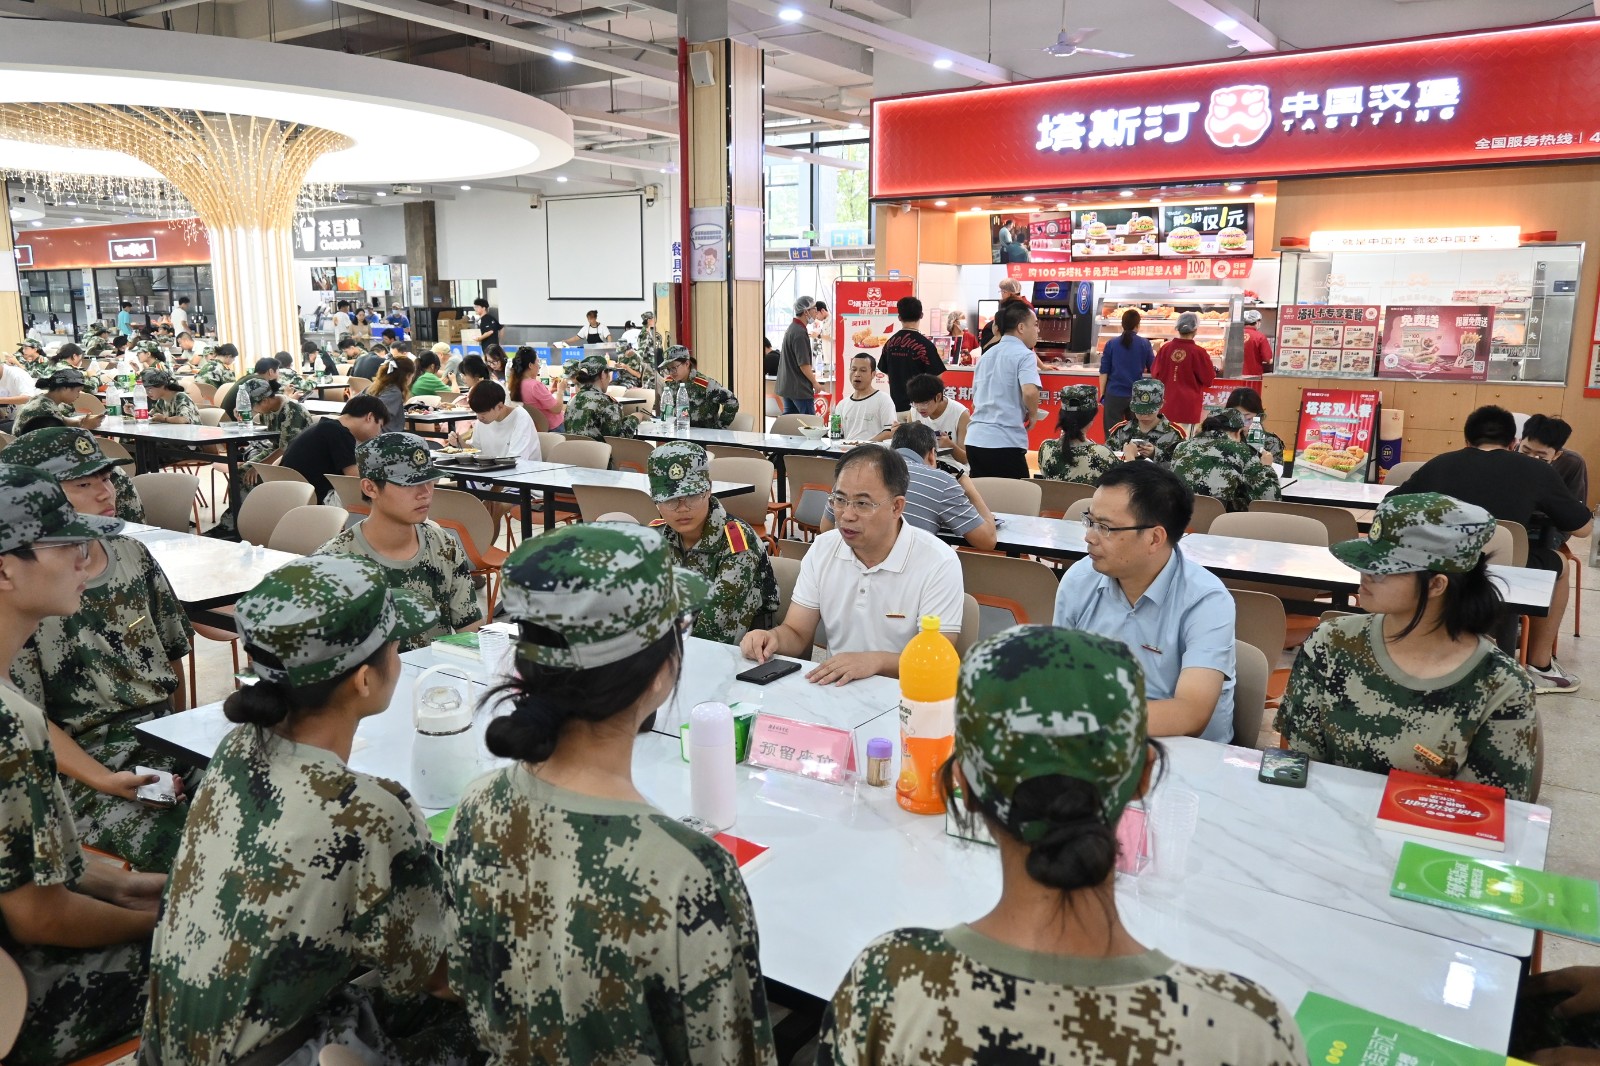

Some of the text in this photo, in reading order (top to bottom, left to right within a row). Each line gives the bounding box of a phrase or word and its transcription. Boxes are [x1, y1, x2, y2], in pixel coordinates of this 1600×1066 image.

[1281, 78, 1460, 118] 中国汉堡
[1036, 101, 1199, 153] 塔斯汀
[1282, 107, 1455, 131] TASITING
[1475, 133, 1572, 149] 全国服务热线
[792, 250, 808, 259] 出口
[1400, 315, 1440, 328] 免费送
[1305, 401, 1372, 418] 塔塔双人餐
